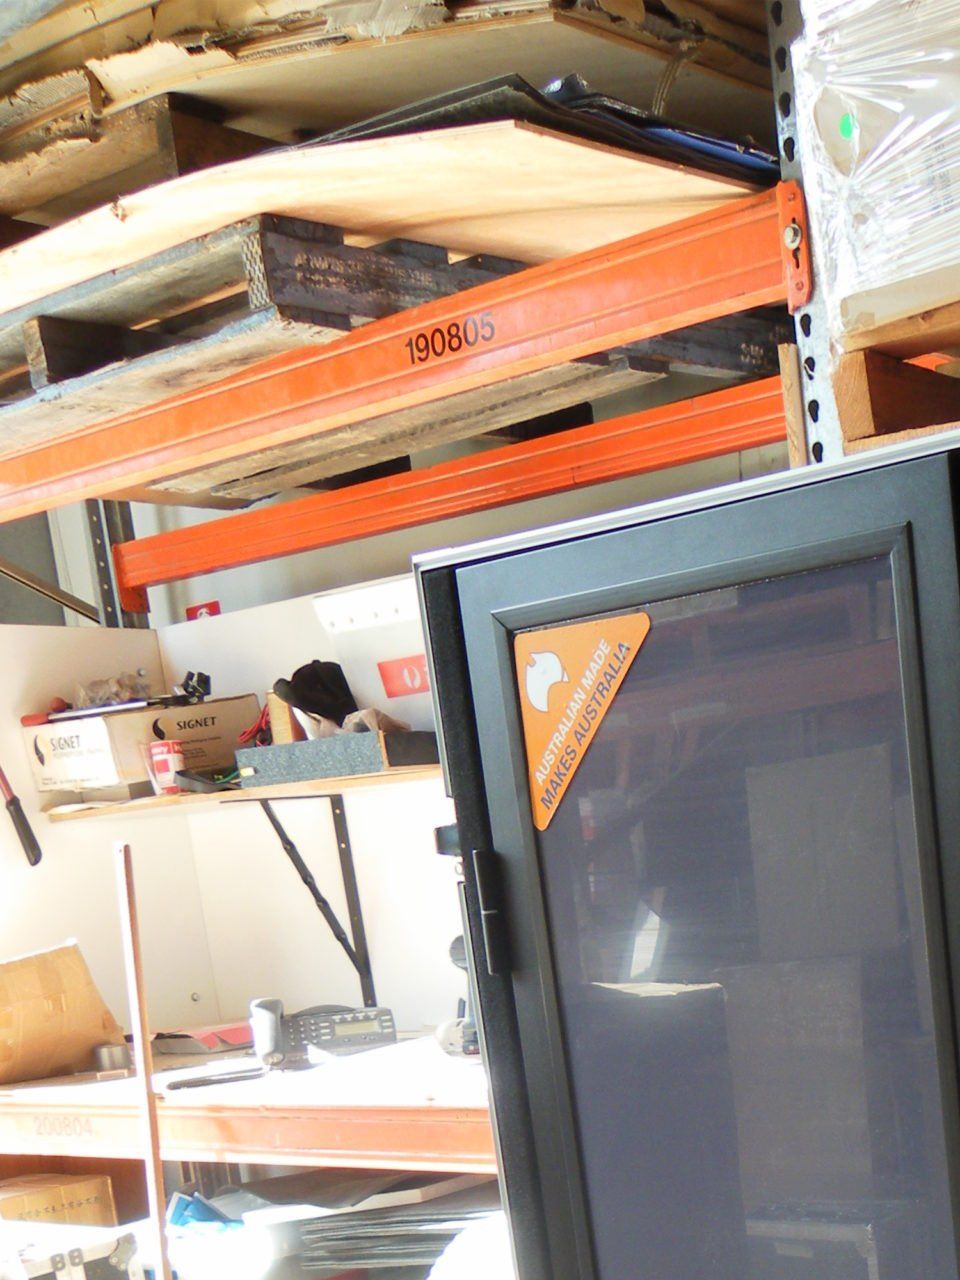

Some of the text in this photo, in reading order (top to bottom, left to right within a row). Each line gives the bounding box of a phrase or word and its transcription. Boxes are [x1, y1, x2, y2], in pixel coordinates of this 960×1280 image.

[404, 311, 496, 364] 190805
[176, 716, 217, 731] SIGNET
[533, 638, 611, 786] AUSTRALIAN MADE
[540, 641, 631, 810] MAKES AUSTRALIA
[50, 734, 81, 752] SIGNET
